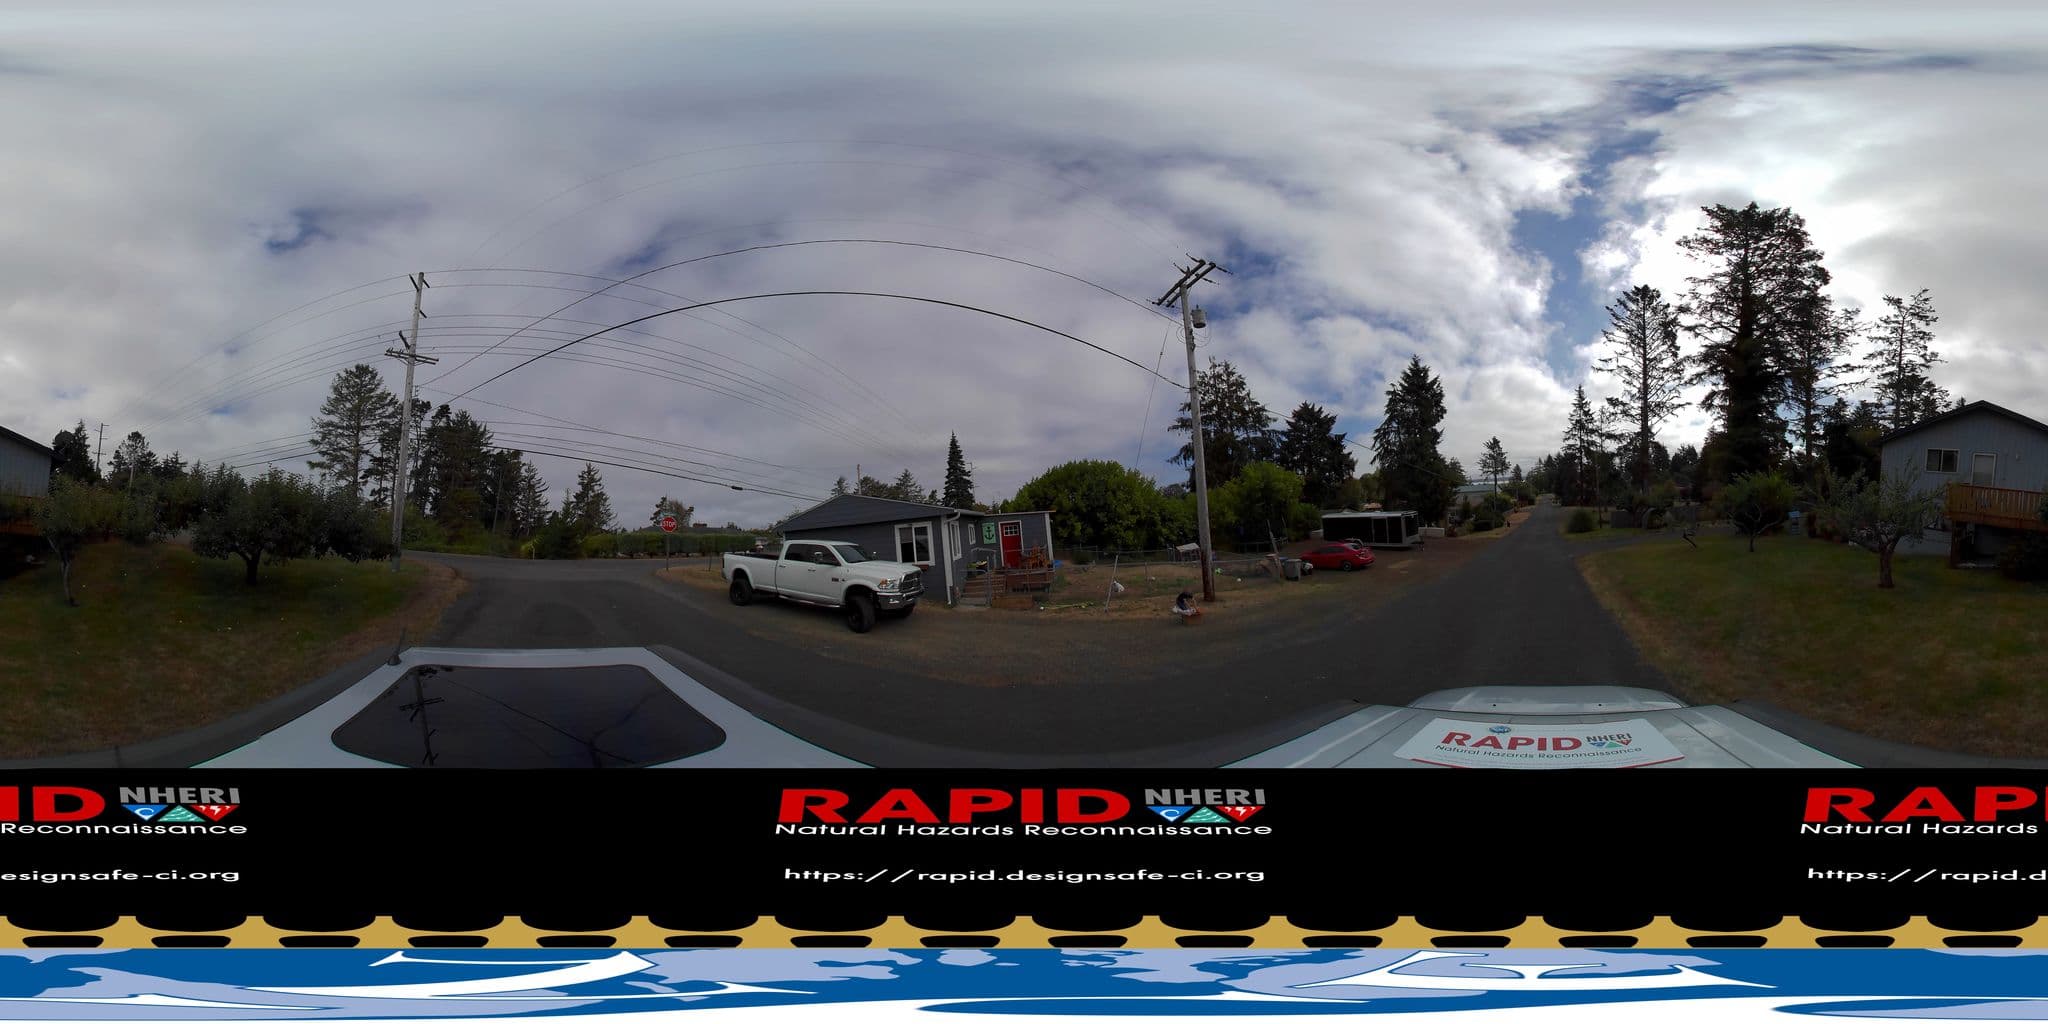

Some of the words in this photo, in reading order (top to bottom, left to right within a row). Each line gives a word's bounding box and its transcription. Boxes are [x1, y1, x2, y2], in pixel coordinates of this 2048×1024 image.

[663, 520, 676, 528] STOP
[1441, 732, 1582, 751] RAPID
[1586, 733, 1632, 743] NHERI
[1435, 745, 1480, 756] Natural
[1483, 750, 1534, 759] Hazards
[1538, 747, 1642, 759] Reconnaissance
